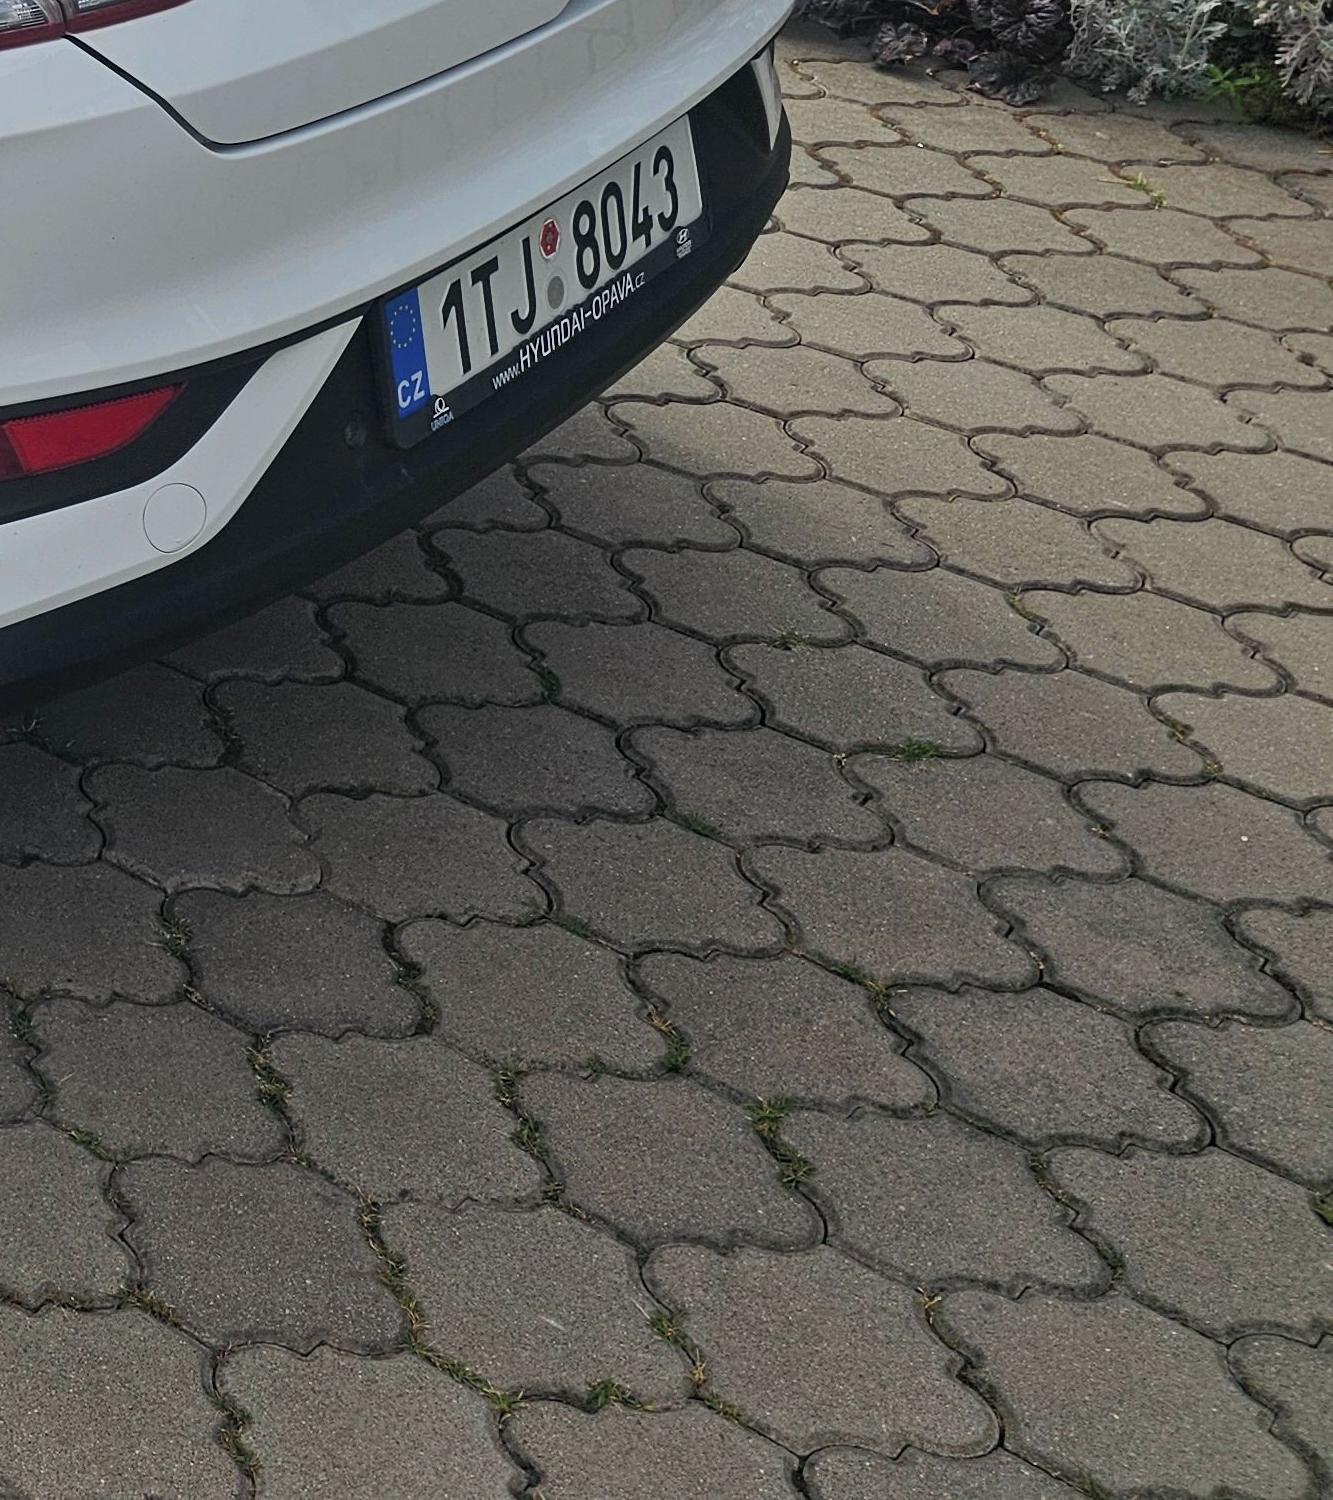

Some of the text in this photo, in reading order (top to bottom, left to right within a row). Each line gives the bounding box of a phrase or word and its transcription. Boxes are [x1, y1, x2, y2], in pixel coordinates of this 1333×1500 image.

[441, 145, 679, 377] 1TJ 8043
[397, 370, 426, 409] CZ
